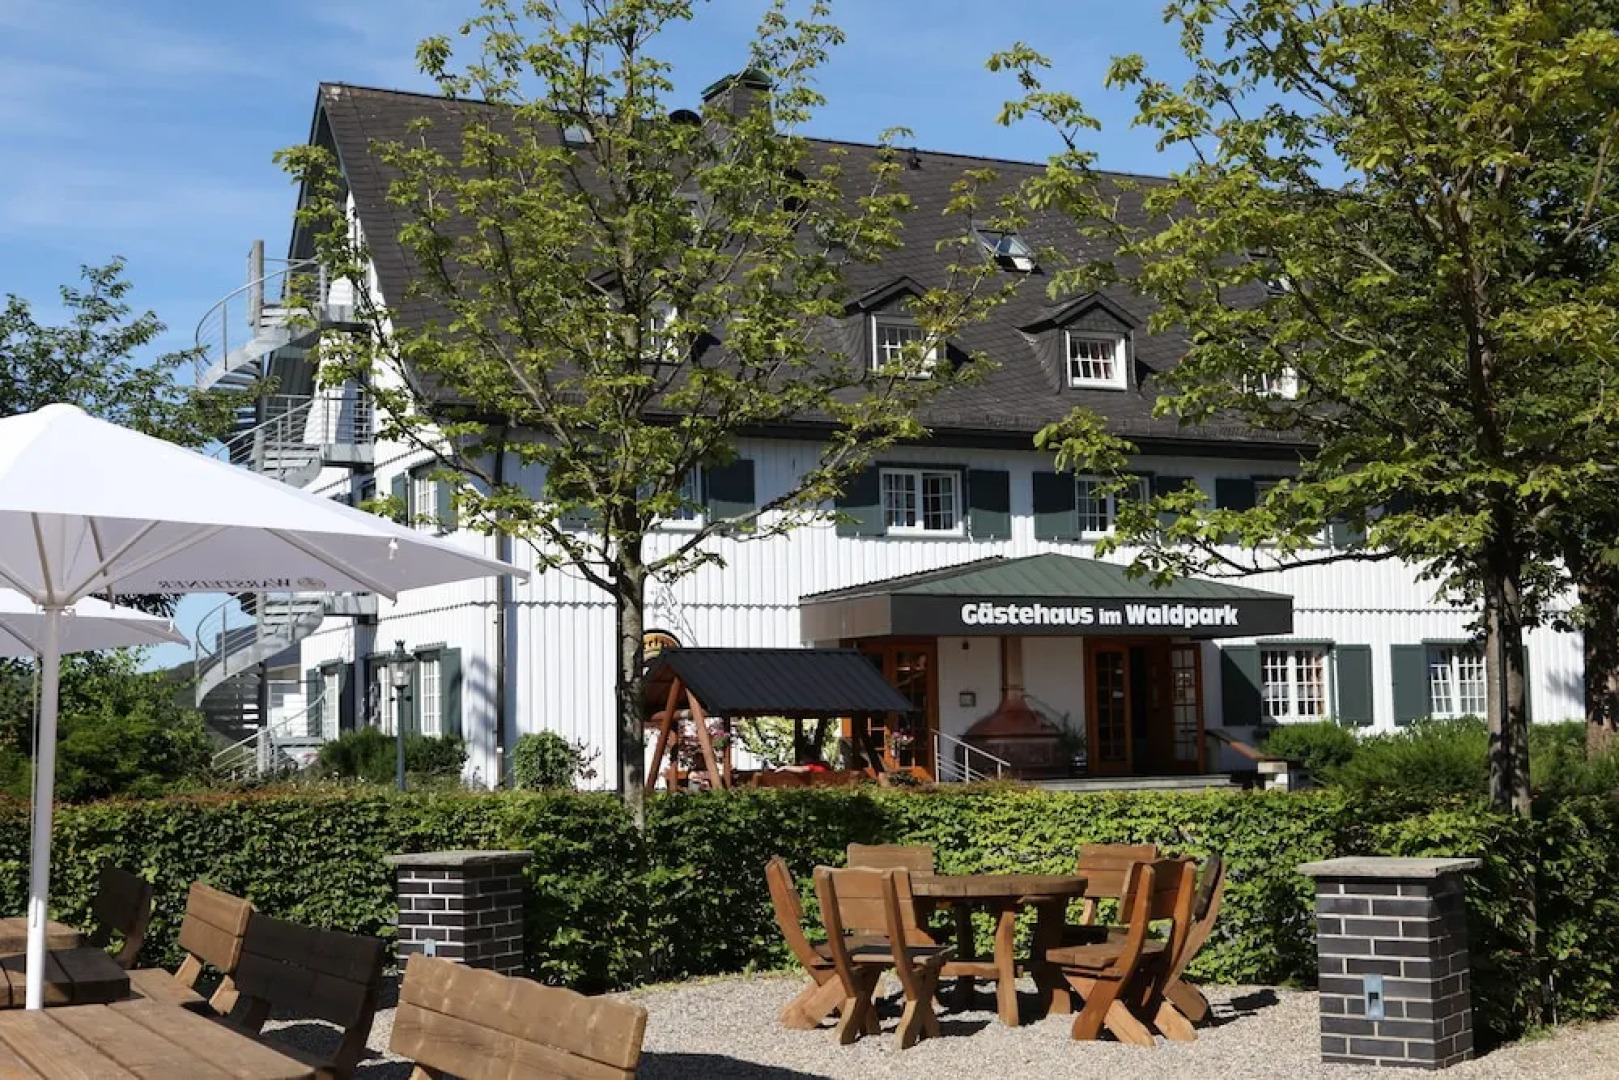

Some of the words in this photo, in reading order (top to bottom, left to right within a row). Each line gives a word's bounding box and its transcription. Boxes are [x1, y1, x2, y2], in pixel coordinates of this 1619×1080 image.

[961, 603, 1094, 625] Gästehaus
[1099, 608, 1122, 625] im
[1125, 603, 1238, 628] Waldpark
